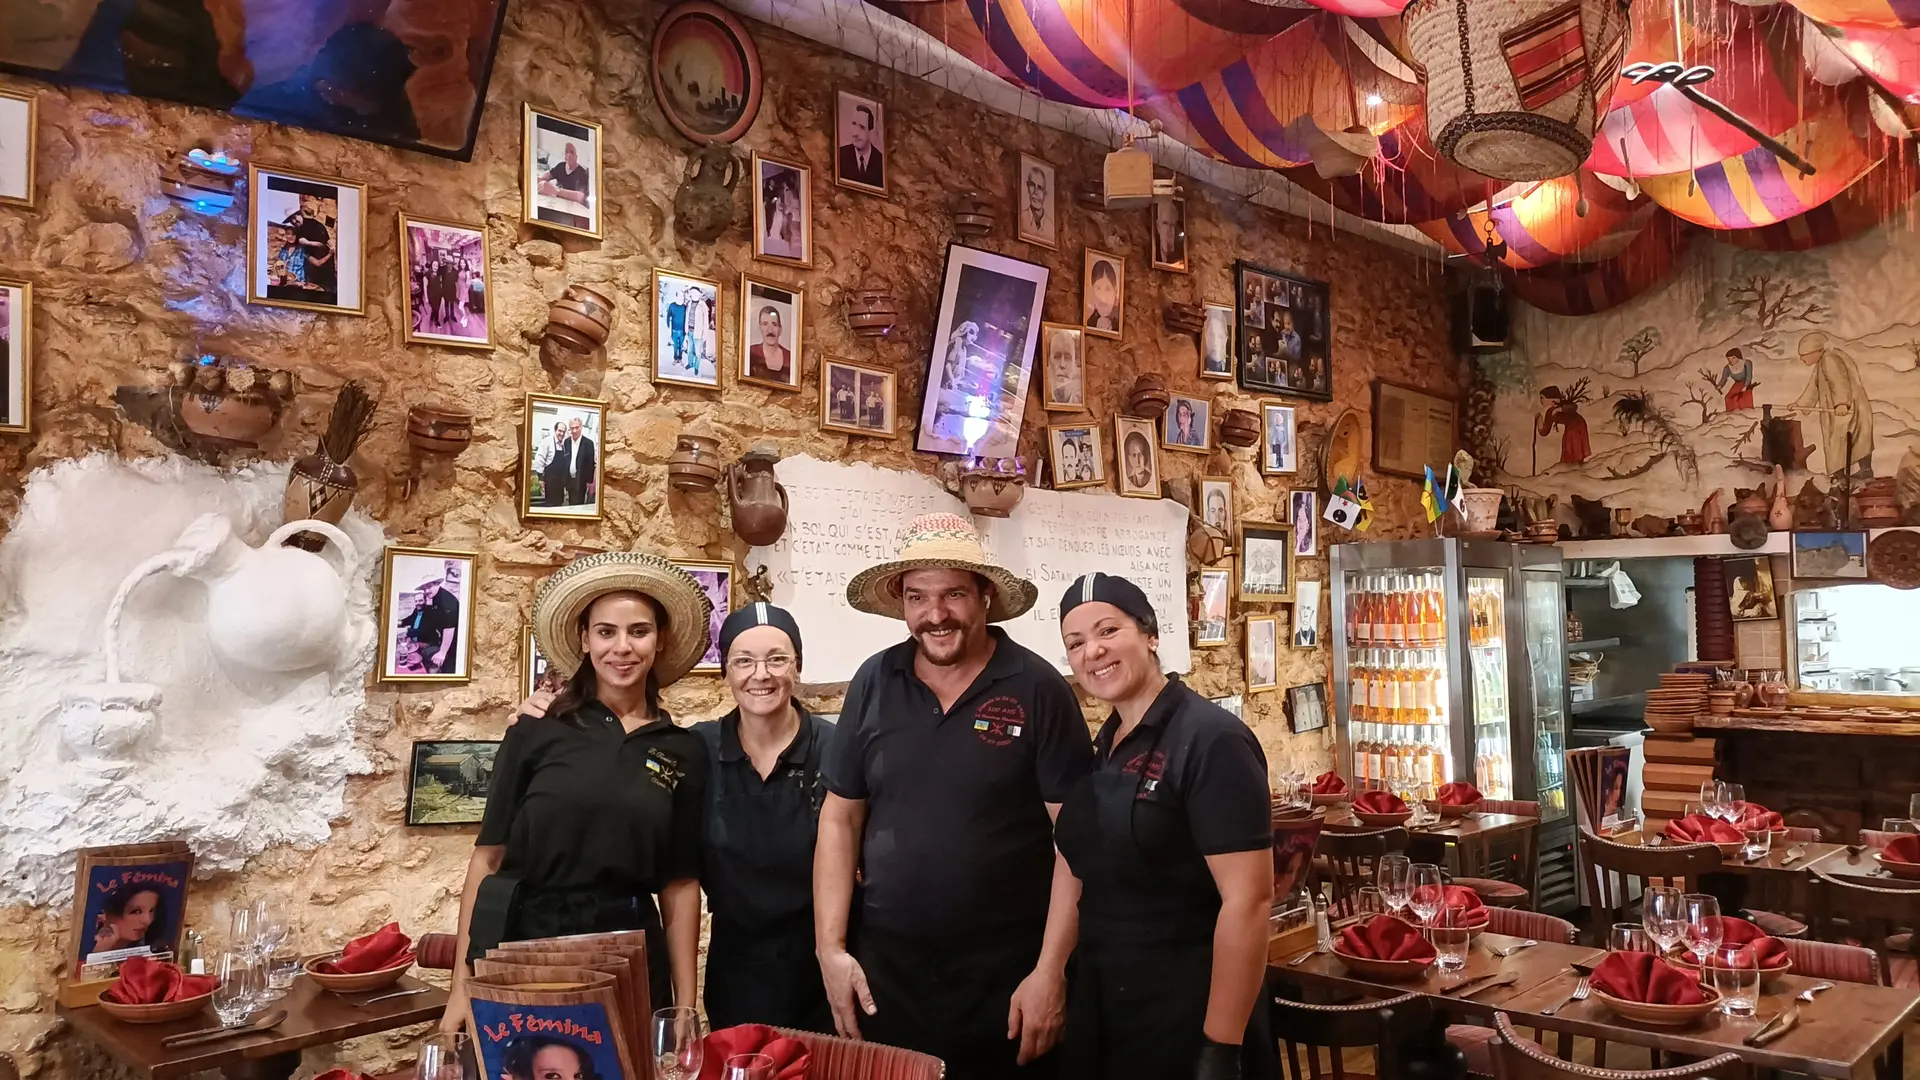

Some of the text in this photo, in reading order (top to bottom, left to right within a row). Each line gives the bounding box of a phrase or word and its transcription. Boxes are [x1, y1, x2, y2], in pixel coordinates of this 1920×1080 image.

[802, 521, 825, 537] BOL
[828, 523, 849, 538] QUI
[1114, 529, 1168, 543] ARROGANCE
[774, 538, 788, 553] ET
[834, 543, 871, 559] COMME
[874, 544, 890, 560] IL
[1023, 535, 1172, 559] ET SAIT DÉNOUER LES NŒUDS AVEC
[1130, 561, 1171, 574] AISANCE
[1025, 568, 1037, 581] SI
[1158, 577, 1172, 589] UN
[1156, 593, 1173, 604] VIN
[1033, 609, 1045, 622] IL
[96, 879, 118, 893] Le
[484, 1023, 510, 1043] Le
